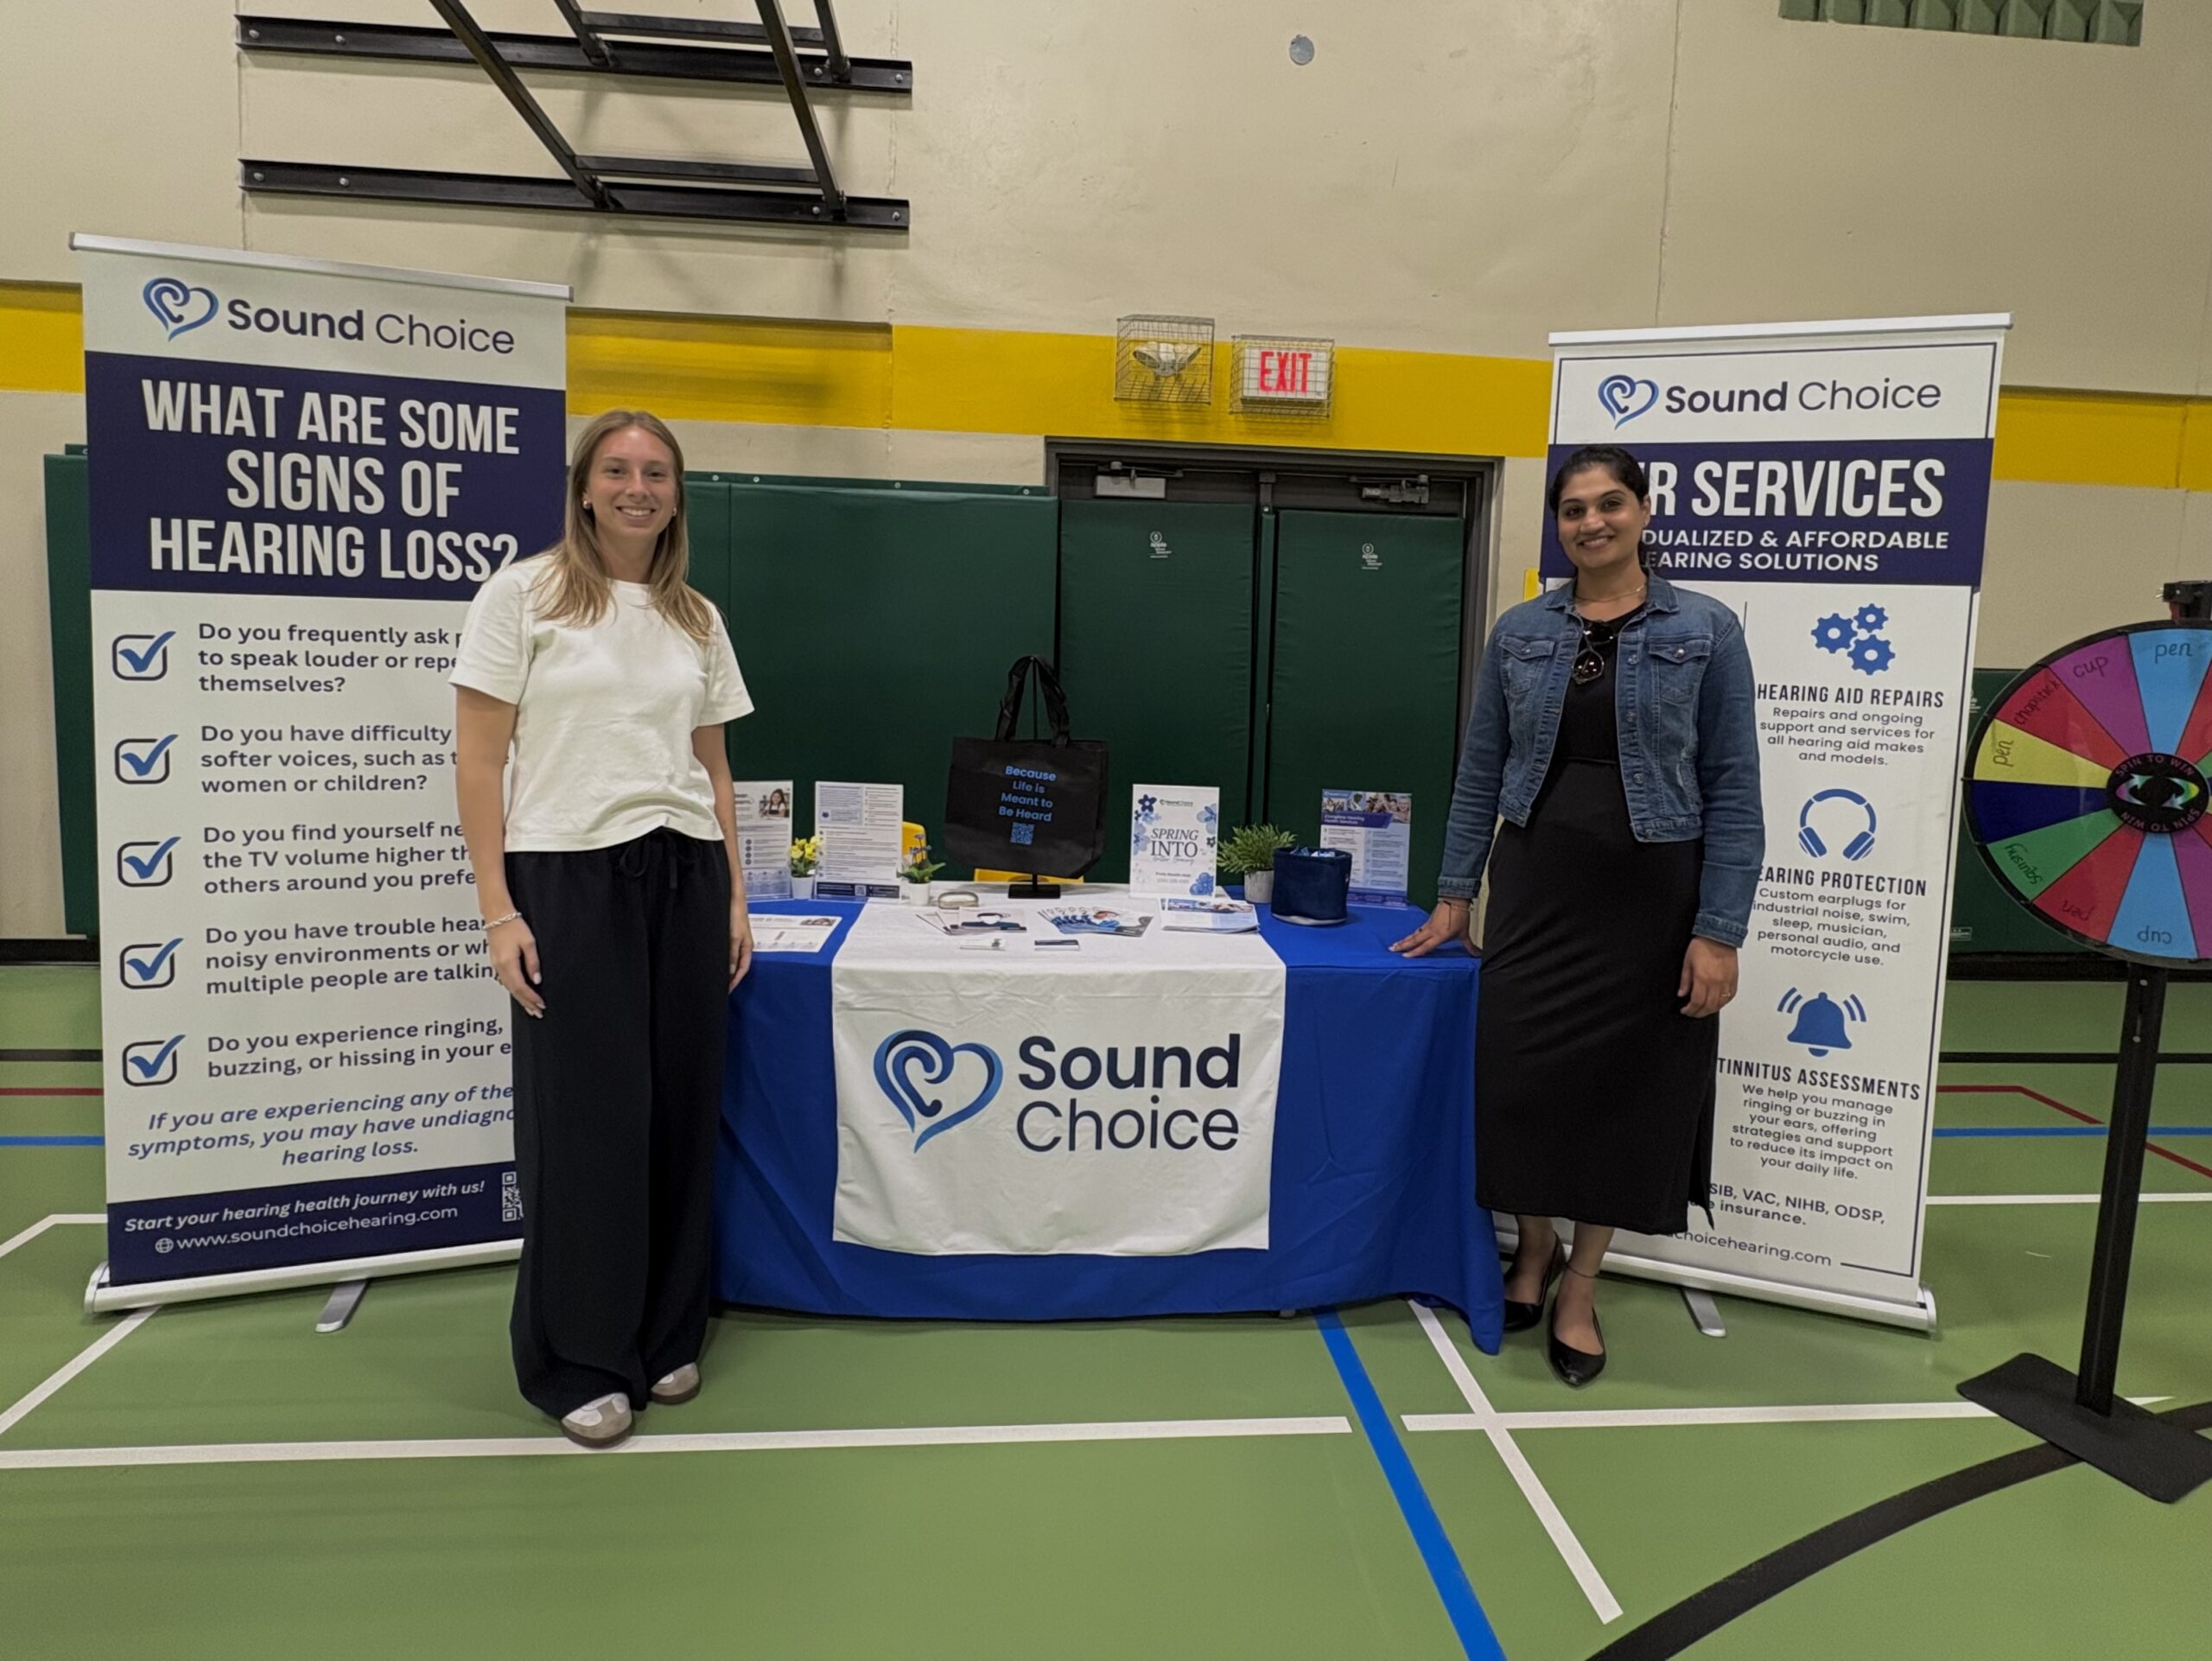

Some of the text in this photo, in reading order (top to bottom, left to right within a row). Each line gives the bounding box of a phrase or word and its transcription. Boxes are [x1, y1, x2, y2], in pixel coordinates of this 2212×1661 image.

[228, 299, 514, 353] Sound Choice
[1260, 352, 1312, 392] EXIT
[1666, 378, 1941, 413] Sound Choice
[142, 379, 518, 454] WHAT ARE SOME
[227, 449, 461, 517] SIGNS OF
[1692, 459, 1945, 517] SERVICES
[151, 518, 364, 577] HEARING
[1759, 530, 1778, 548] &
[1785, 531, 1949, 550] AFFORDABLE
[1738, 552, 1878, 571] SOLUTIONS
[199, 622, 232, 640] Do
[238, 627, 281, 645] you
[288, 625, 408, 647] frequently
[414, 627, 449, 645] ask
[230, 649, 298, 671] speak
[304, 650, 379, 668] louder
[2155, 643, 2193, 664] pen
[2074, 657, 2108, 678] cup
[198, 674, 346, 692] themselves?
[1757, 684, 1944, 709] HEARING AID REPAIRS
[1772, 706, 1923, 728] Repairs ongoing
[201, 724, 452, 747] Do you have difficulty
[1760, 722, 1910, 738] support services
[1788, 735, 1924, 754] hearing makes
[1993, 741, 2013, 767] pen
[200, 749, 416, 770] softer voices, such
[1830, 754, 1888, 766] models.
[201, 774, 428, 793] women children?
[1005, 765, 1057, 782] Because
[1013, 780, 1046, 794] Life is
[1001, 792, 1053, 809] Meant to
[998, 805, 1052, 822] Be Heard
[204, 826, 236, 843] Do
[242, 829, 284, 847] you
[291, 824, 336, 841] find
[343, 822, 435, 843] yourself
[1150, 828, 1199, 841] SPRING
[202, 846, 446, 869] the TV volume higher
[1151, 840, 1198, 858] INTO
[204, 876, 281, 894] others
[286, 872, 367, 891] around
[373, 875, 413, 893] you
[1821, 872, 1926, 896] PROTECTION
[1758, 888, 1882, 911] Custom earplugs
[2061, 900, 2094, 920] pen
[1752, 900, 1910, 927] industrial noise, swim,
[206, 927, 238, 944] Do
[244, 927, 287, 947] you
[295, 923, 348, 939] have
[353, 918, 435, 937] trouble
[1772, 917, 1886, 939] sleep, musician,
[2136, 925, 2172, 945] cup
[1757, 931, 1867, 951] personal audio,
[206, 944, 431, 971] noisy environments
[1770, 945, 1885, 966] motorcycle use.
[207, 974, 303, 995] multiple
[311, 970, 387, 992] people
[394, 970, 429, 983] are
[207, 1017, 503, 1054] Do you experience ringing,
[208, 1057, 302, 1078] buzzing,
[339, 1047, 416, 1067] hissing
[446, 1043, 495, 1064] your
[1019, 1034, 1240, 1090] Sound
[1718, 1058, 1919, 1104] TINNITUS ASSESSMENTS
[168, 1112, 214, 1133] you
[220, 1108, 258, 1123] are
[264, 1095, 404, 1121] experiencing
[410, 1091, 450, 1109] any
[1742, 1083, 1893, 1116] We help you manage
[1017, 1095, 1238, 1152] Choice
[1743, 1098, 1868, 1128] ringing buzzing
[128, 1134, 254, 1160] symptoms,
[259, 1128, 304, 1149] you
[309, 1123, 359, 1141] may
[362, 1117, 416, 1135] have
[1749, 1113, 1878, 1142] your ears, offering
[1732, 1124, 1893, 1157] strategies support
[282, 1141, 418, 1166] hearing loss.
[1747, 1141, 1871, 1168] reduce impact
[1760, 1156, 1858, 1180] your daily life.
[124, 1180, 486, 1232] Start your hearing health journey with us!
[1720, 1200, 1806, 1225] insurance.
[1742, 1188, 1780, 1207] VAC,
[1785, 1195, 1829, 1215] NIHB,
[1834, 1204, 1885, 1225] ODSP,
[177, 1205, 458, 1250] www.soundchoicehearing.com
